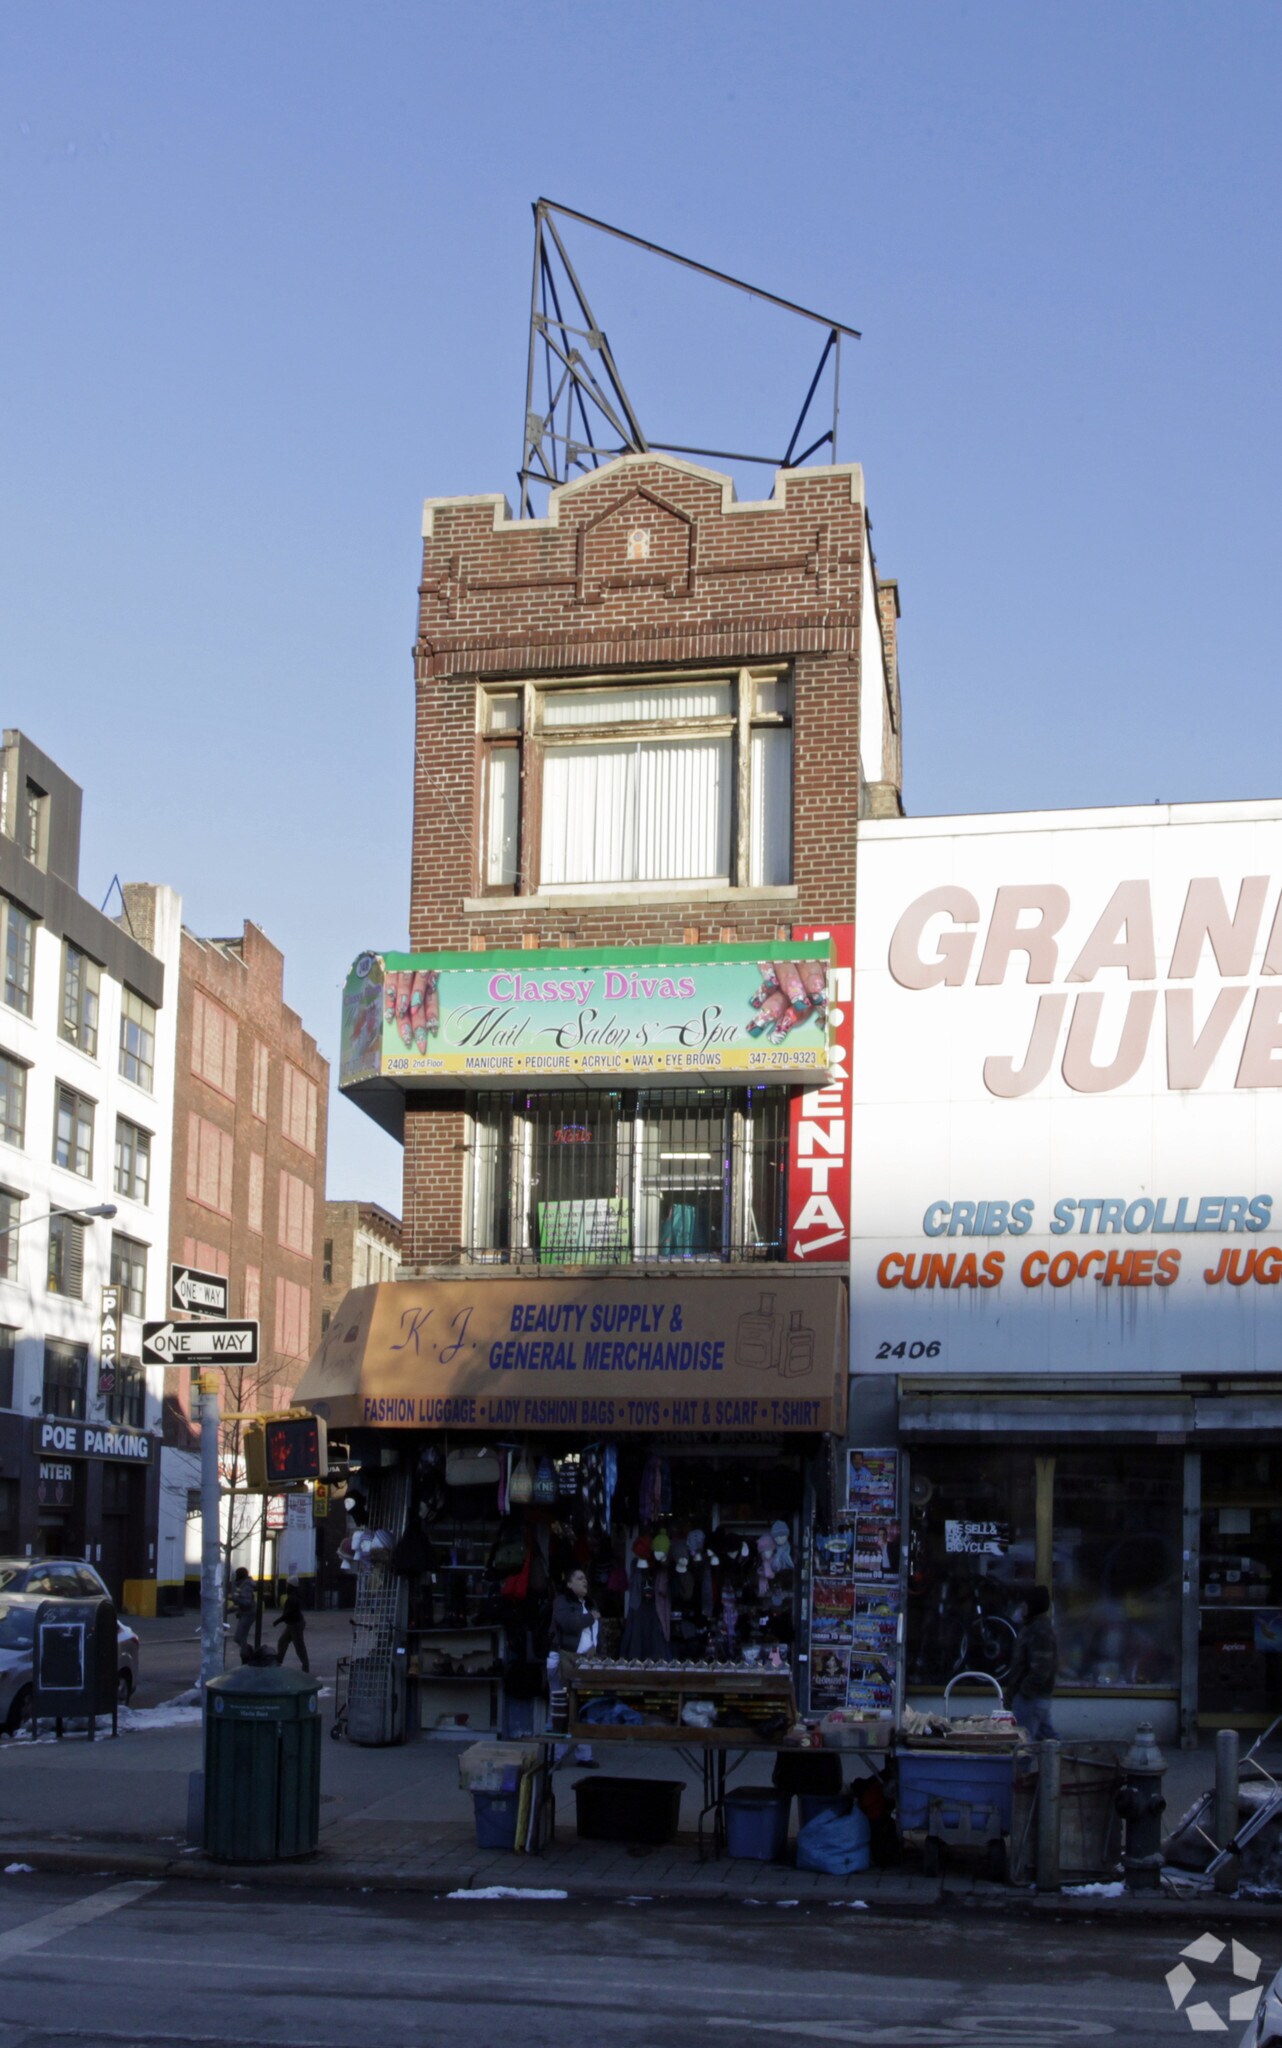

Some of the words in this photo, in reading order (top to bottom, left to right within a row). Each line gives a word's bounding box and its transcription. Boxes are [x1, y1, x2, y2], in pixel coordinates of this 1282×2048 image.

[888, 874, 1282, 991] GRAN
[488, 972, 595, 1005] Classy
[603, 971, 696, 999] Divas
[445, 1006, 531, 1048] Nail
[537, 1007, 631, 1050] Salon
[659, 1005, 739, 1053] Spa
[388, 1058, 408, 1070] 2408
[413, 1059, 425, 1068] 2nd
[427, 1059, 443, 1068] Floor
[466, 1056, 514, 1068] MANICURE
[525, 1056, 570, 1068] PEDICURE
[581, 1055, 621, 1067] ACRYLIC
[633, 1055, 654, 1066] WAX
[665, 1054, 683, 1065] EYE
[686, 1053, 721, 1065] BROWS
[749, 1052, 816, 1065] 347-270-9323
[923, 1199, 1035, 1237] CRIBS
[1049, 1194, 1273, 1235] STROLLERS
[876, 1250, 1005, 1289] CUNAS
[1020, 1248, 1181, 1287] COCHES
[1203, 1247, 1282, 1287] JUG
[180, 1281, 197, 1300] ONE
[204, 1287, 221, 1305] WAY
[101, 1297, 117, 1369] PARK
[510, 1304, 588, 1332] BEAUTY
[590, 1304, 665, 1332] SUPPLY
[669, 1304, 683, 1332] &
[154, 1335, 191, 1352] ONE
[212, 1334, 247, 1351] WAY
[489, 1341, 577, 1370] GENERAL
[582, 1341, 725, 1371] MERCHANDISE
[875, 1341, 941, 1360] 2406
[364, 1398, 415, 1421] FASHION
[419, 1398, 476, 1423] LUGGAGE
[489, 1399, 520, 1423] LADY
[524, 1399, 577, 1424] FASHION
[581, 1400, 615, 1425] BAGS
[628, 1401, 660, 1425] TOYS
[672, 1401, 698, 1425] HAT
[702, 1401, 711, 1425] &
[715, 1401, 758, 1425] SCARF
[771, 1401, 820, 1426] T-SHIRT
[42, 1424, 76, 1450] POE
[84, 1429, 149, 1458] PARKING
[40, 1463, 72, 1480] NTER
